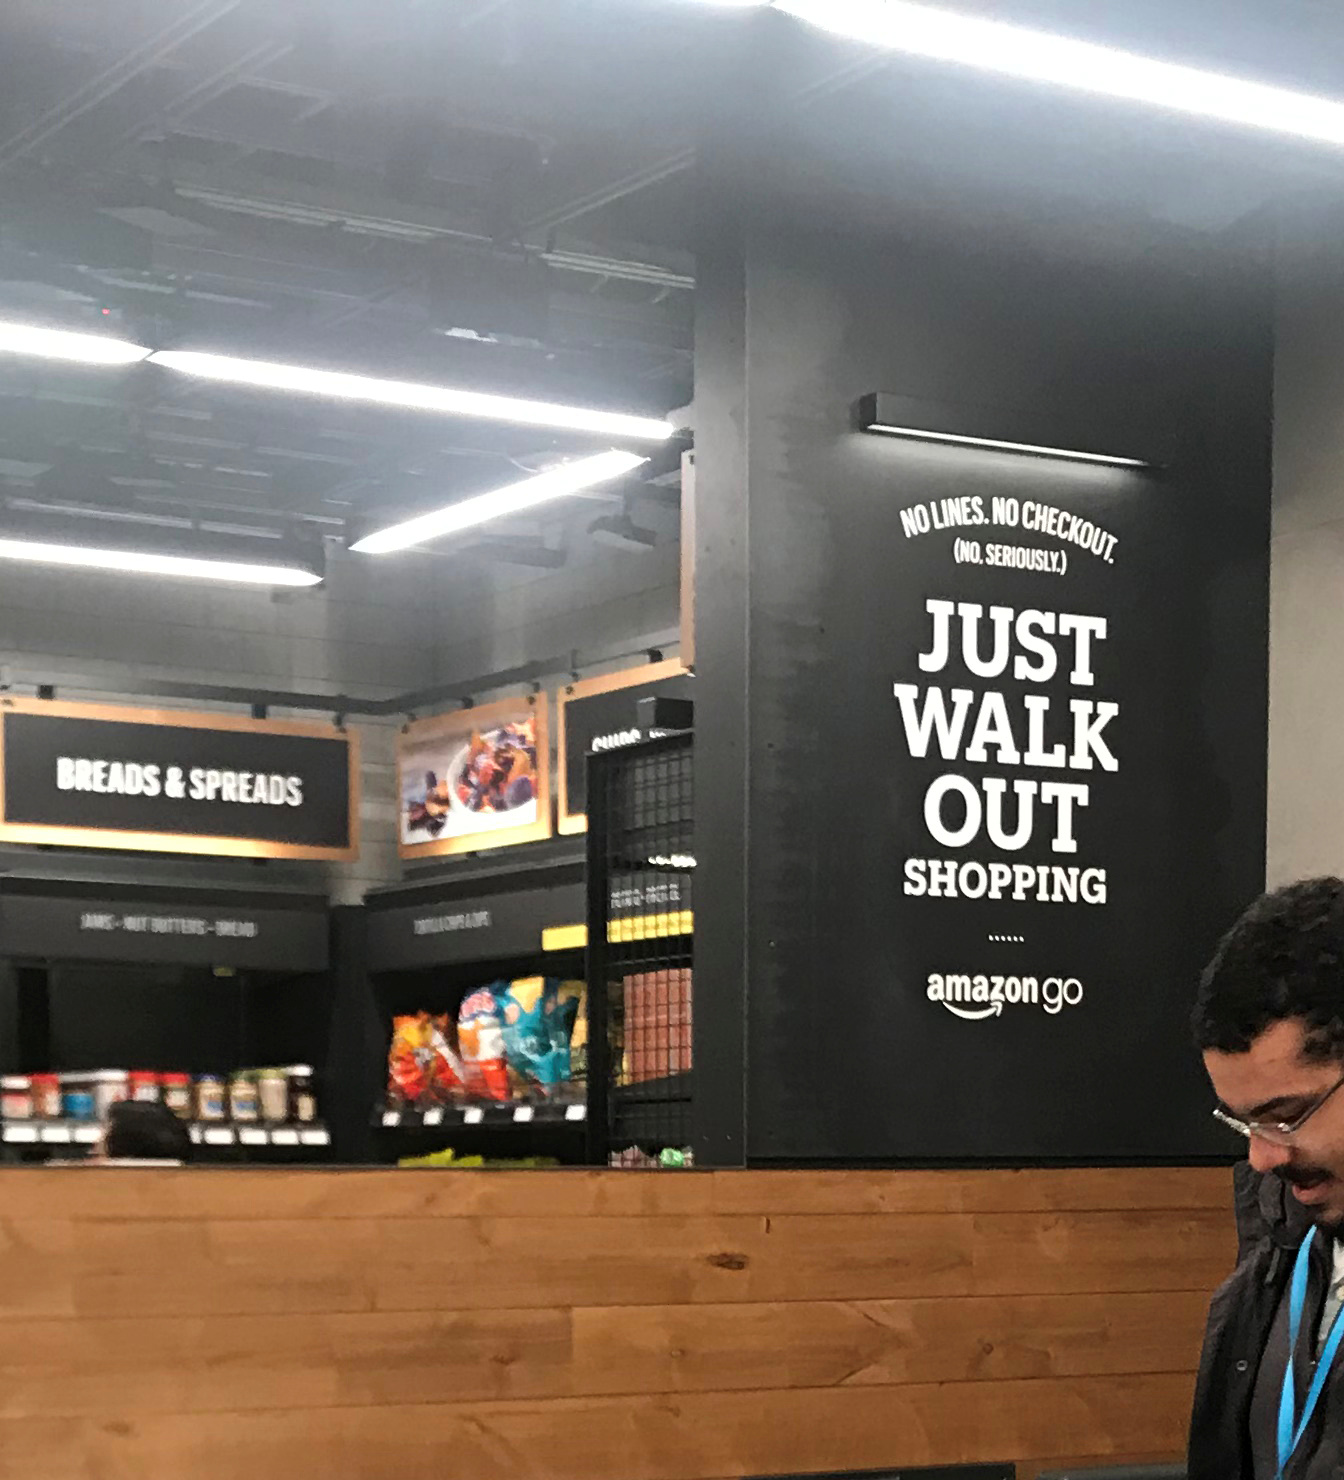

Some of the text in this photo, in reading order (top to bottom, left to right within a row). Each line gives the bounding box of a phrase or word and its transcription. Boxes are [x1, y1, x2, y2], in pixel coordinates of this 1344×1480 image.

[899, 496, 1119, 564] NO LINES. NO CHECKOUT.
[953, 537, 1068, 576] (NO. SERIOUSLY.)
[918, 599, 1107, 686] JUST
[893, 683, 1119, 772] WALK
[56, 756, 304, 807] BREADS & SPREADS
[924, 774, 1090, 854] OUT
[903, 858, 1107, 905] SHOPPING
[926, 973, 1084, 1015] amazon go
